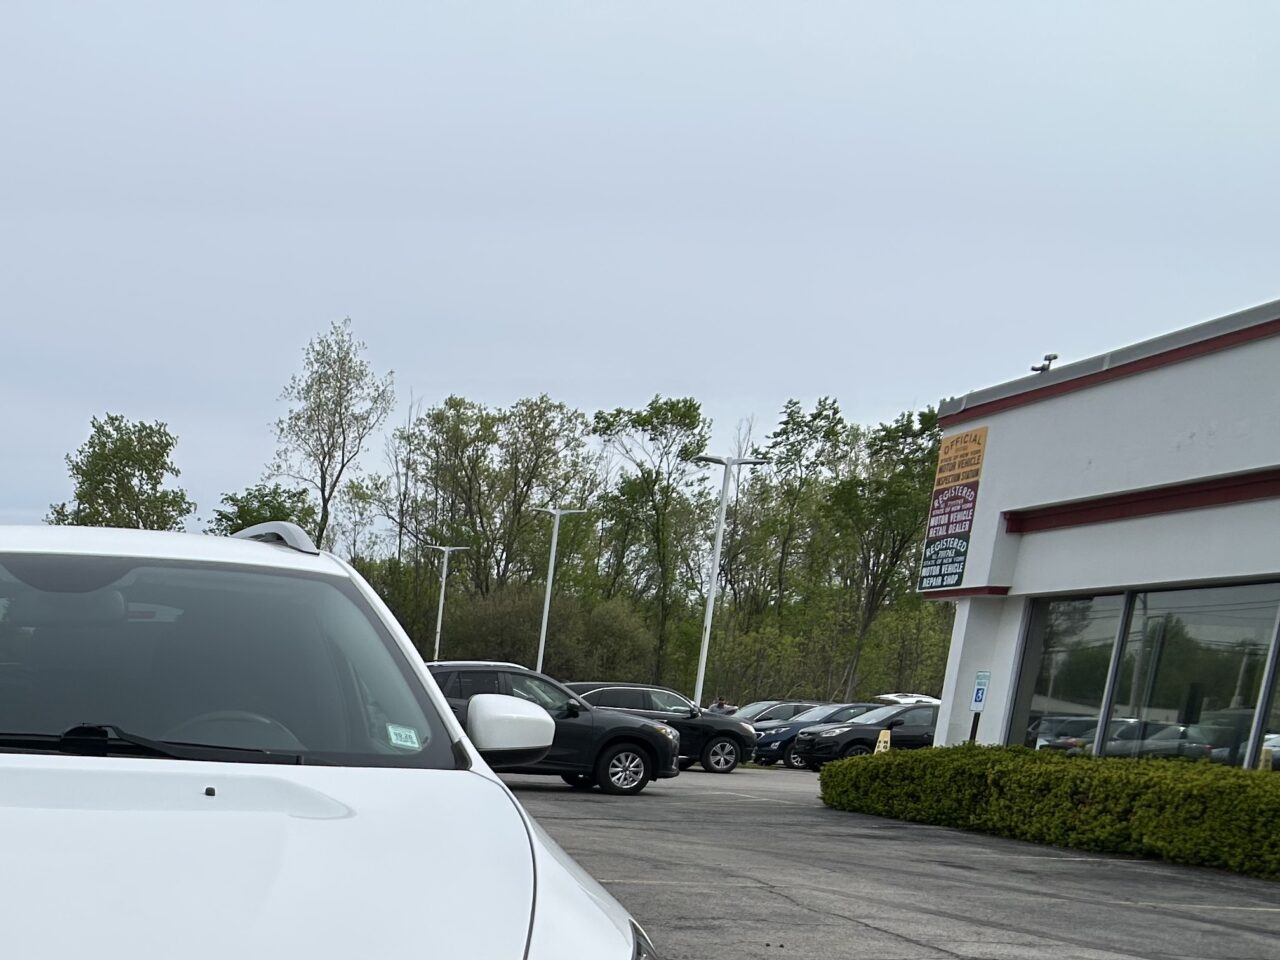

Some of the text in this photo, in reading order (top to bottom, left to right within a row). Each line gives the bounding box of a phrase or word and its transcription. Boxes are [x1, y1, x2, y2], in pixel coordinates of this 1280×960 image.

[944, 433, 982, 455] OFFICIAL
[939, 455, 981, 474] MOTOR VEHICLE
[936, 468, 979, 486] INSPECTION STATION
[934, 486, 975, 508] REGISTERED
[930, 508, 973, 527] MOTOR VEHICLE
[929, 521, 970, 538] RETAIL DEALER
[925, 537, 967, 558] REGISTERED
[921, 562, 964, 577] MOTOR VEHICLE
[922, 574, 959, 588] REPAIR SHOP
